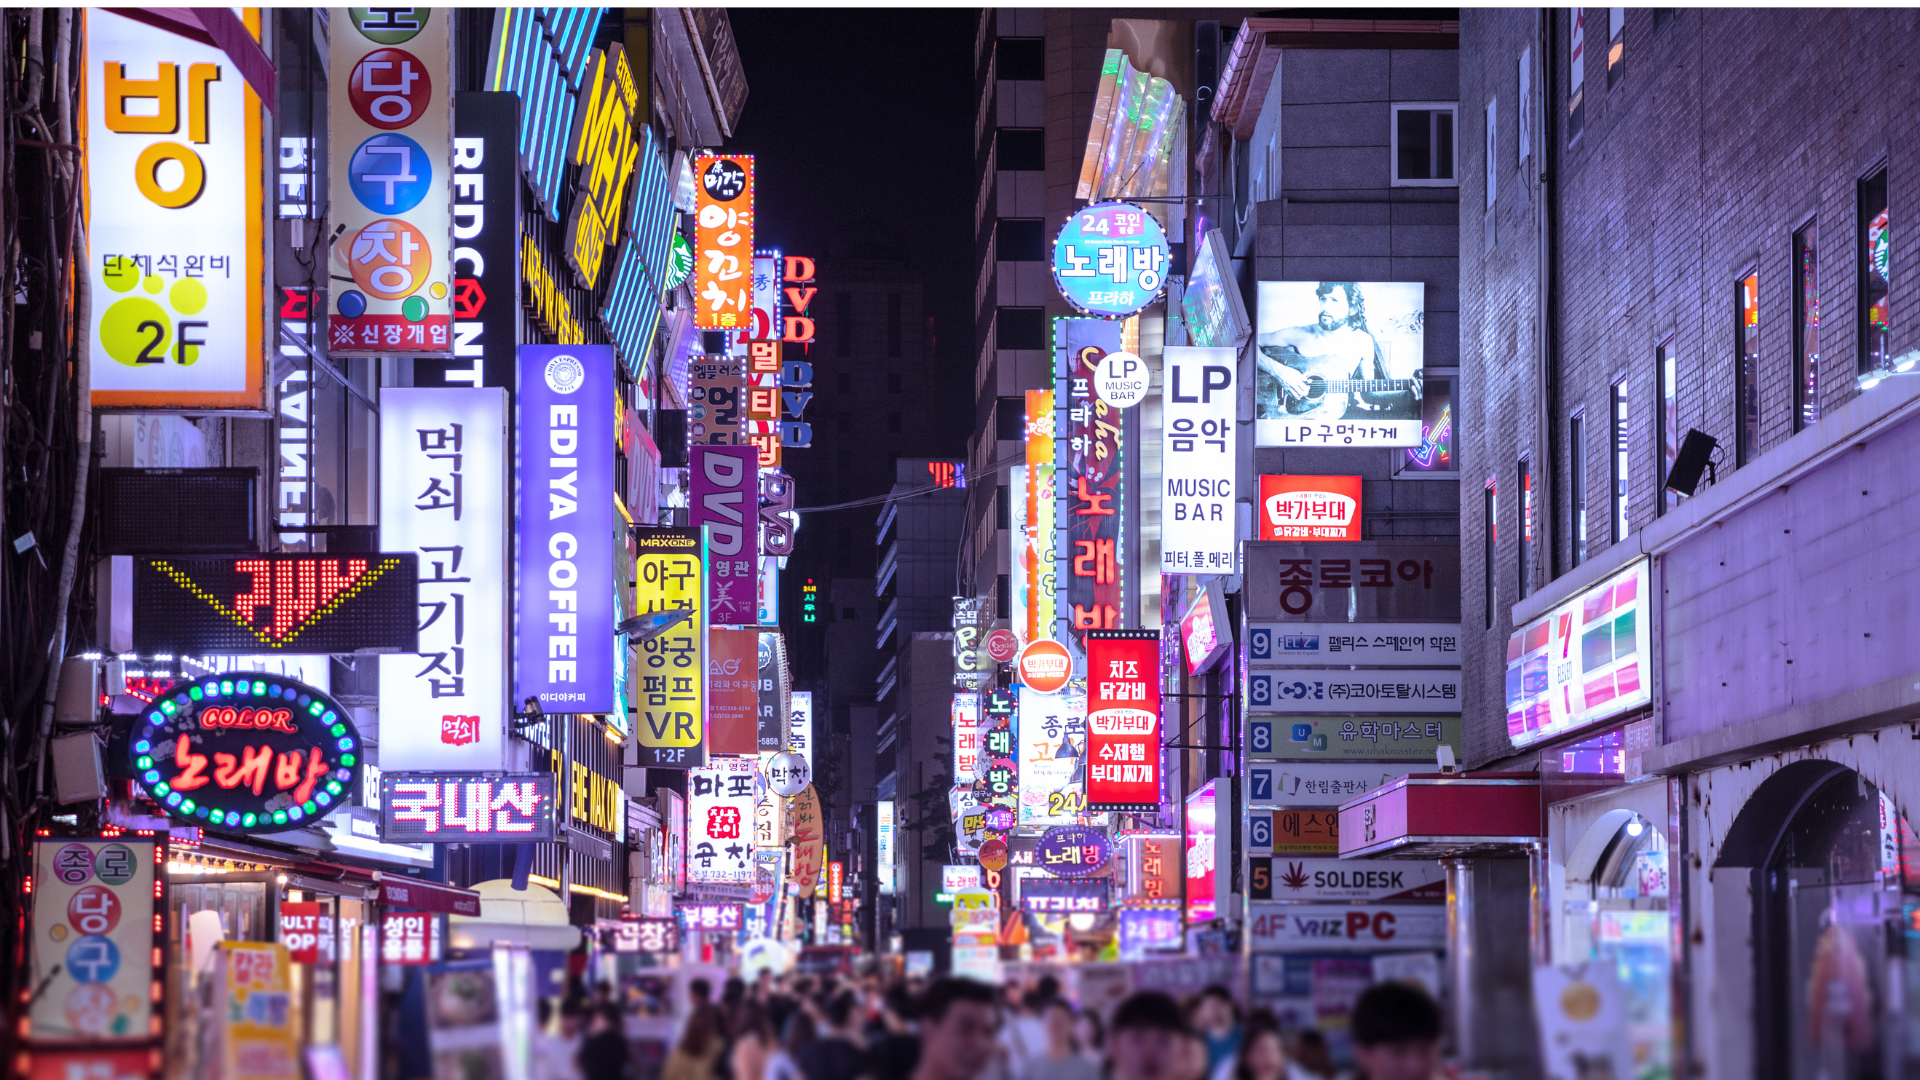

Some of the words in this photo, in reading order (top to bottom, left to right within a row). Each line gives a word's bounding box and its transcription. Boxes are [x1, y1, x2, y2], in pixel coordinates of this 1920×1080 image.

[616, 49, 639, 117] EXTREME
[103, 60, 222, 209] 방
[576, 50, 639, 246] MAX
[1082, 214, 1110, 235] 24
[1113, 213, 1140, 227] 코인
[102, 253, 231, 279] 단체석완비
[1059, 245, 1165, 291] 노래방
[782, 256, 818, 342] DVD
[1087, 290, 1135, 306] 프라하
[135, 319, 209, 364] 2F
[360, 324, 448, 346] 신장개업
[693, 364, 742, 380] 엠플러스
[1108, 360, 1138, 379] LP
[1105, 381, 1142, 390] MUSIC
[1171, 365, 1232, 403] LP
[781, 360, 814, 447] DVD
[1110, 391, 1135, 400] BAR
[1070, 378, 1093, 457] 프라하
[1168, 417, 1231, 453] 음악
[1285, 425, 1312, 442] LP
[1316, 424, 1397, 444] 구멍가게
[414, 422, 463, 521] 먹쇠
[549, 404, 578, 521] EDIYA
[1168, 478, 1231, 498] MUSIC
[702, 450, 744, 557] DVD
[1174, 502, 1223, 522] BAR
[1276, 500, 1346, 521] 박가부대
[709, 560, 751, 578] 영관
[1164, 550, 1233, 569] 피터.폴.메리
[642, 559, 696, 591] 야구
[710, 580, 737, 612] 美
[1279, 558, 1434, 615] 종로코아
[548, 531, 578, 684] COFFEE
[717, 612, 732, 623] 3F
[414, 545, 472, 699] 고기집
[643, 636, 696, 668] 양궁
[955, 626, 977, 671] PC
[1252, 632, 1270, 655] 9
[1328, 635, 1369, 653] 펠리스
[1372, 635, 1425, 653] 스페인어
[1429, 635, 1457, 653] 학원
[1027, 658, 1064, 669] 박가부대
[1109, 660, 1139, 679] 치즈
[955, 672, 978, 680] ZONE
[540, 692, 586, 702] 이디야커피
[642, 674, 696, 707] 펌프
[1099, 681, 1146, 701] 닭갈비
[1252, 678, 1270, 702] 8
[1277, 681, 1324, 700] CORE
[1328, 682, 1457, 701] (주)코아토탈시스템
[200, 705, 297, 734] COLOR
[442, 716, 478, 745] 먹쇠
[644, 711, 696, 740] VR
[1040, 715, 1085, 739] 종로
[1095, 715, 1149, 731] 박가부대
[958, 712, 977, 772] 노래방
[1252, 726, 1270, 748] 8
[1298, 728, 1306, 737] U
[1313, 737, 1322, 746] M
[1338, 720, 1443, 743] 유학마스터
[988, 693, 1012, 794] 노래방
[1098, 743, 1145, 761] 수제햄
[1342, 745, 1437, 756] www.uhakmaster.ne
[170, 732, 329, 805] 노래방
[728, 762, 749, 772] 영업
[771, 765, 808, 785] 막창
[1091, 764, 1153, 783] 부대찌개
[692, 773, 753, 798] 마포
[1252, 773, 1270, 795] 7
[1304, 779, 1368, 795] 한림출판사
[391, 781, 542, 834] 국내산
[590, 770, 606, 830] MAX
[986, 814, 999, 828] 24
[1000, 813, 1012, 822] 코인
[709, 822, 737, 838] 구이
[1252, 820, 1270, 843] 6
[58, 847, 133, 882] 종로
[694, 841, 753, 869] 곱창
[1045, 844, 1101, 865] 노래방
[710, 870, 752, 879] 732-1197
[946, 875, 978, 888] 노래방
[1253, 867, 1269, 890] 5
[1313, 870, 1405, 889] SOLDESK
[383, 916, 425, 938] 성인
[1252, 914, 1288, 939] 4F
[1345, 911, 1397, 941] PC
